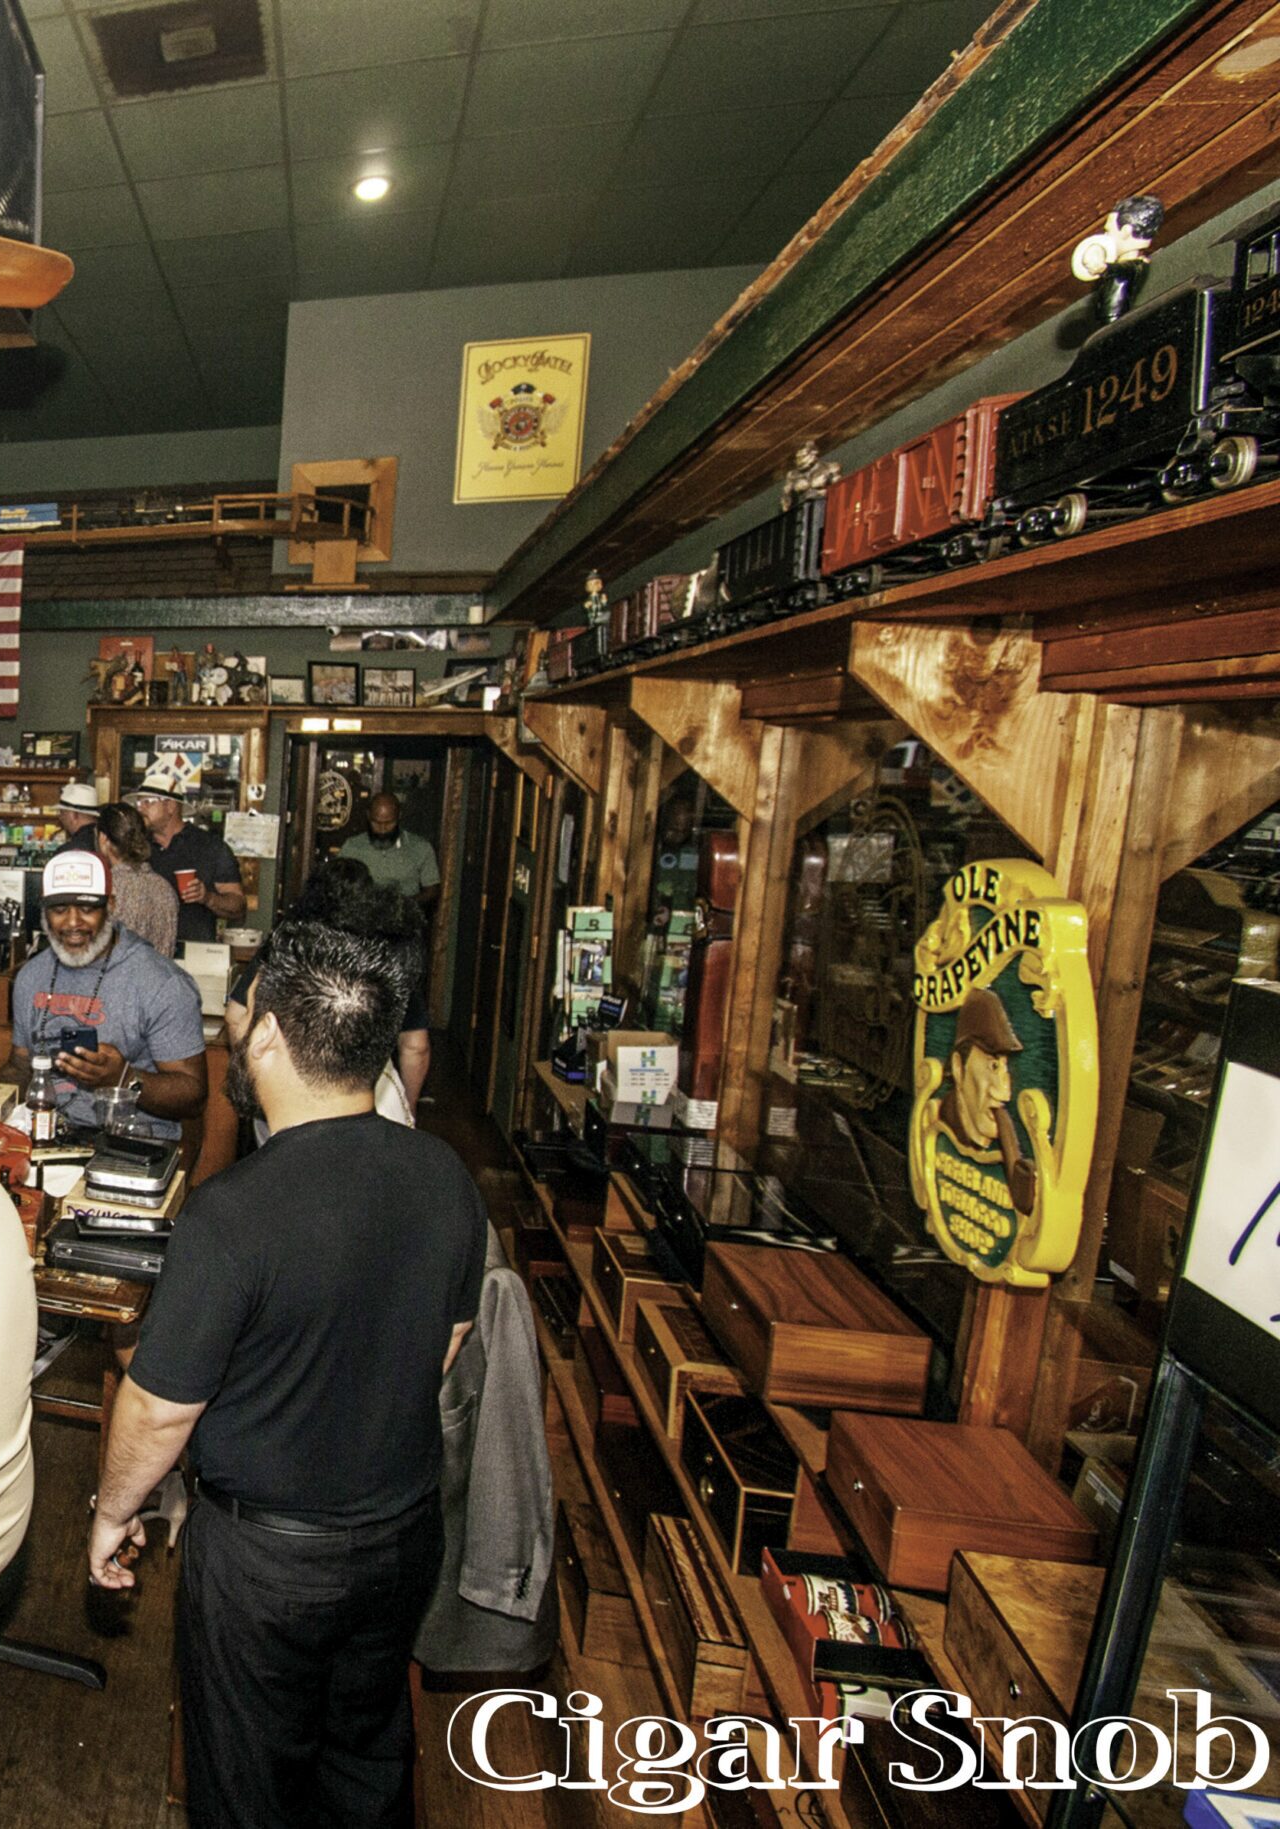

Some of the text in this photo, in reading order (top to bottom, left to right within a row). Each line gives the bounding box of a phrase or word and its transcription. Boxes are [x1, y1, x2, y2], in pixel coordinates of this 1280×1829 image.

[1081, 344, 1179, 435] 1249
[952, 865, 1000, 904] OLE
[913, 909, 1041, 1008] GRAPEVINE
